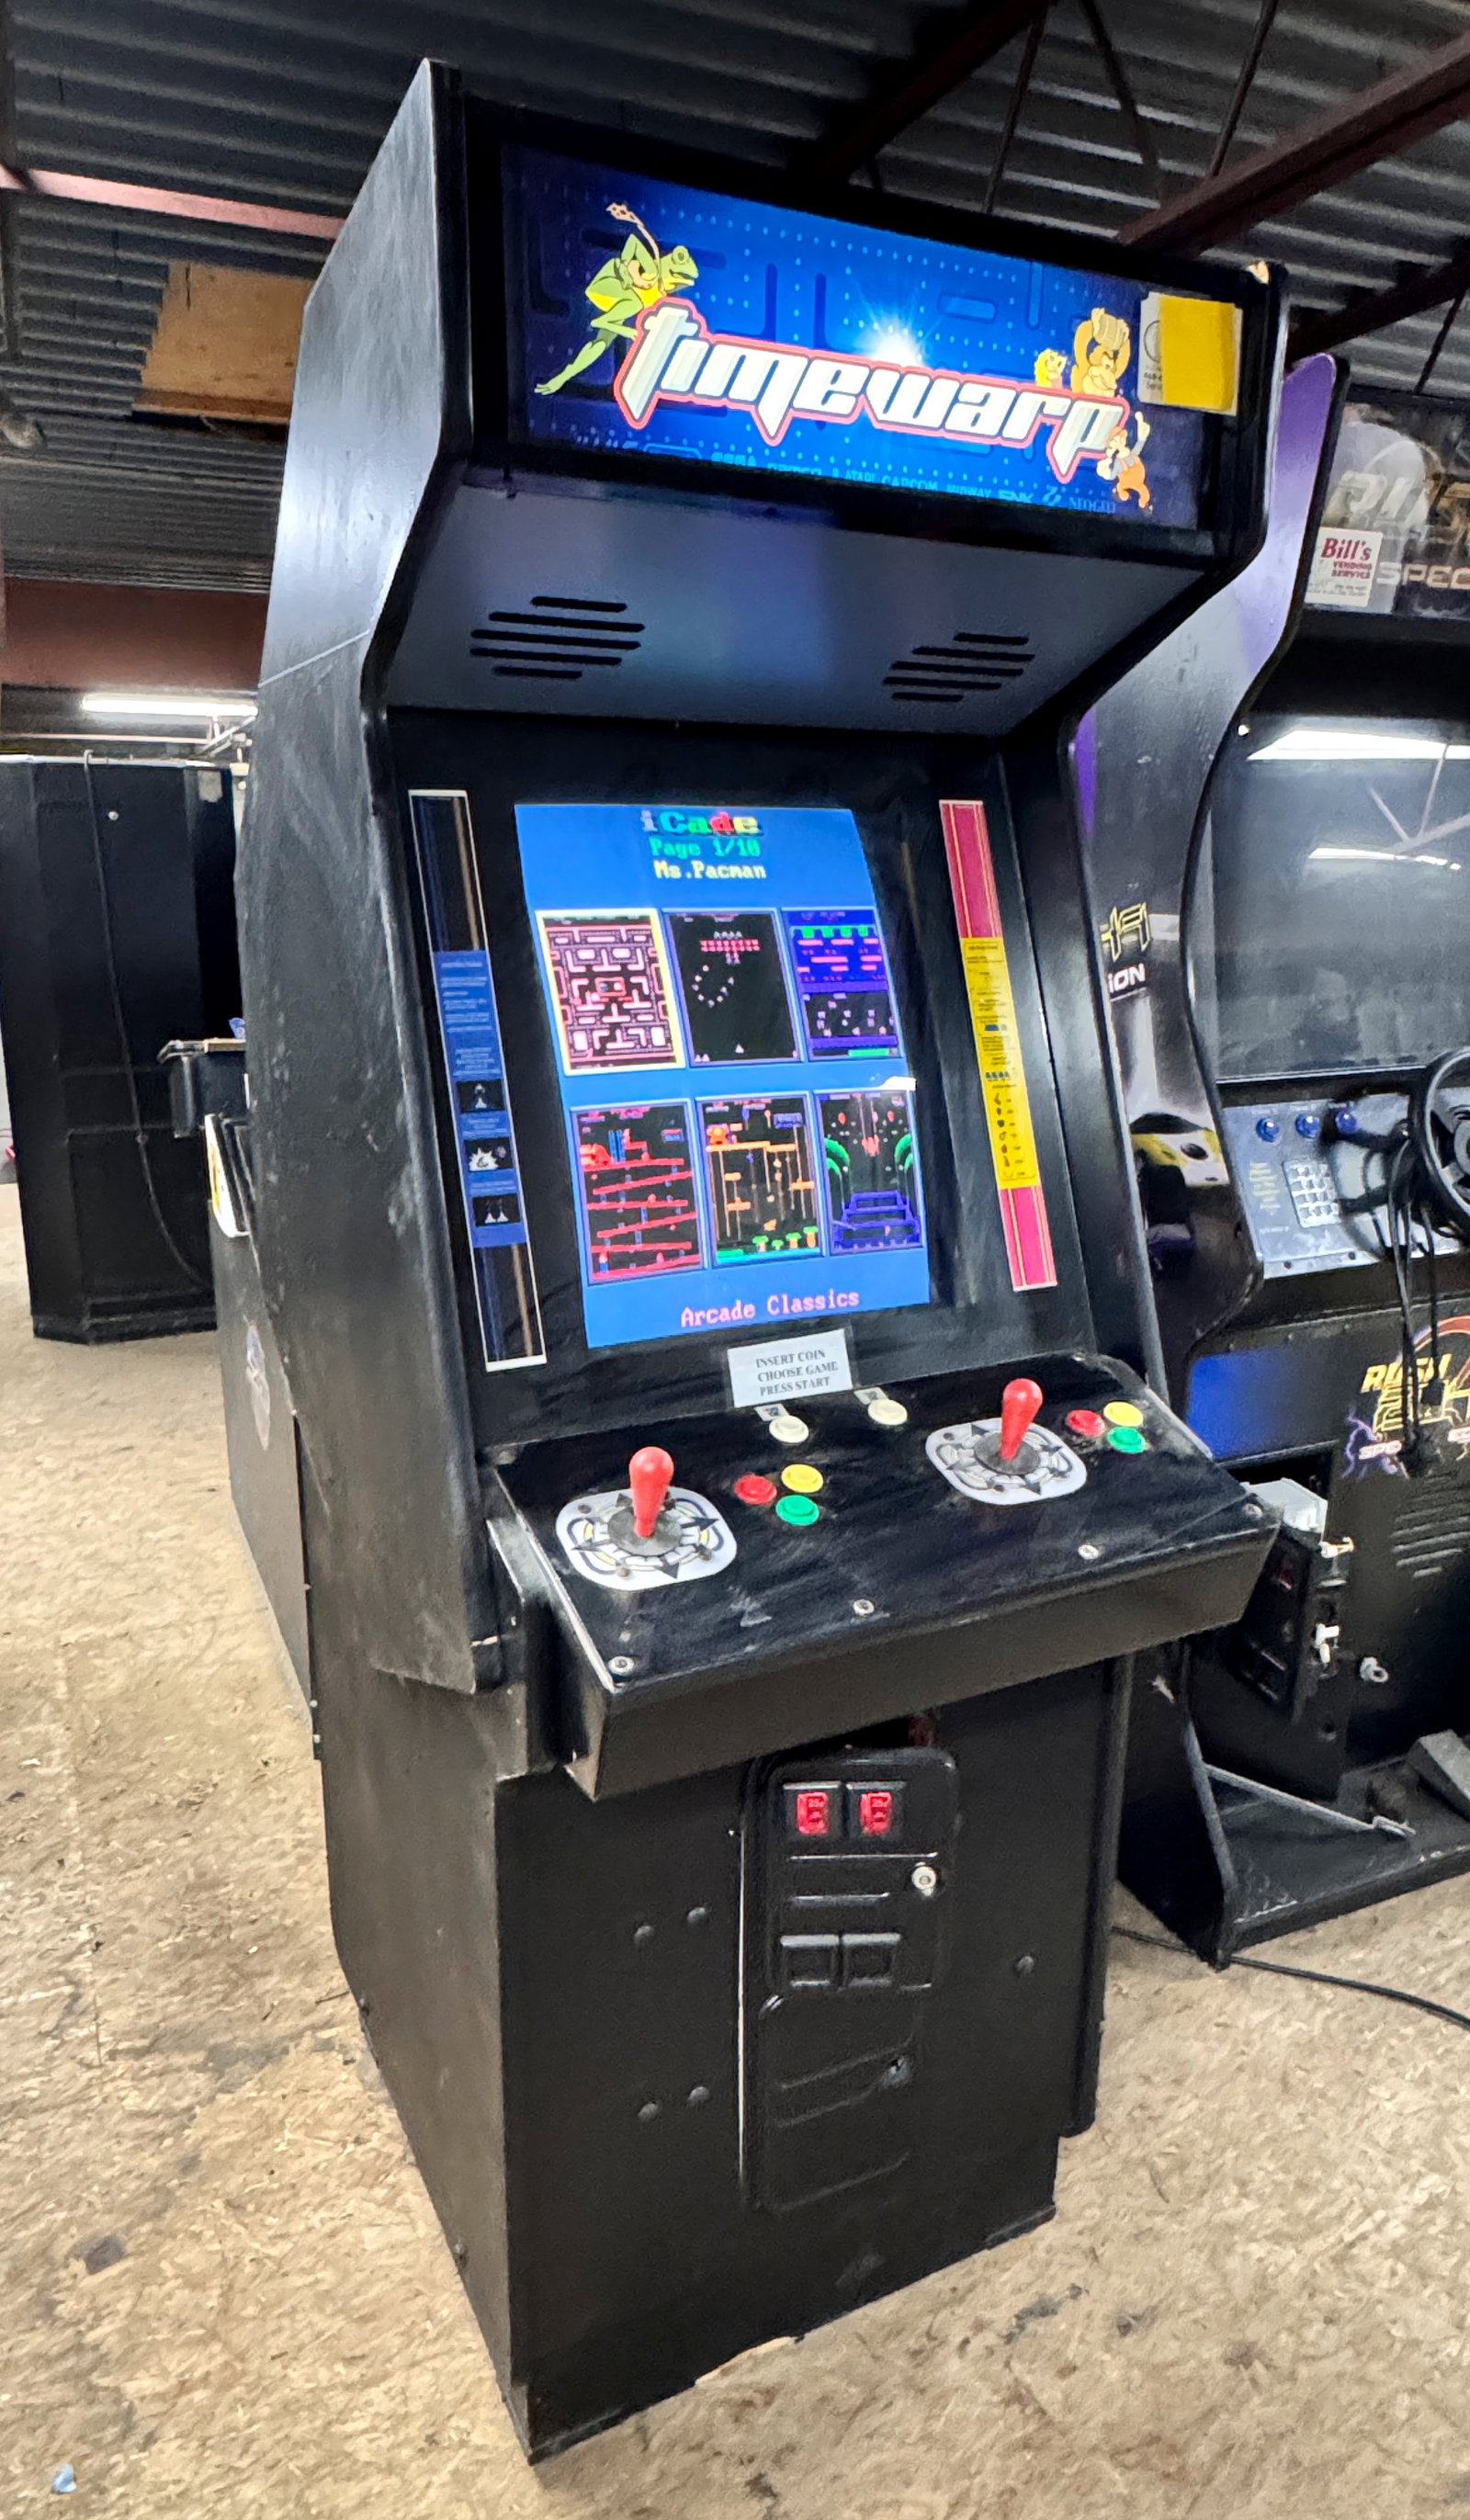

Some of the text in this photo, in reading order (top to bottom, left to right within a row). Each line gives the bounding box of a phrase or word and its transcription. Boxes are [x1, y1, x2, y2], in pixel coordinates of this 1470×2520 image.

[1321, 537, 1373, 561] Bill's
[639, 809, 762, 835] iCade
[649, 836, 761, 860] Page 1/10
[681, 1288, 860, 1328] Arcade Classics
[756, 1349, 826, 1369] INSERT COIN
[757, 1361, 839, 1383] CHOOSE GAME
[759, 1376, 831, 1397] PRESS START
